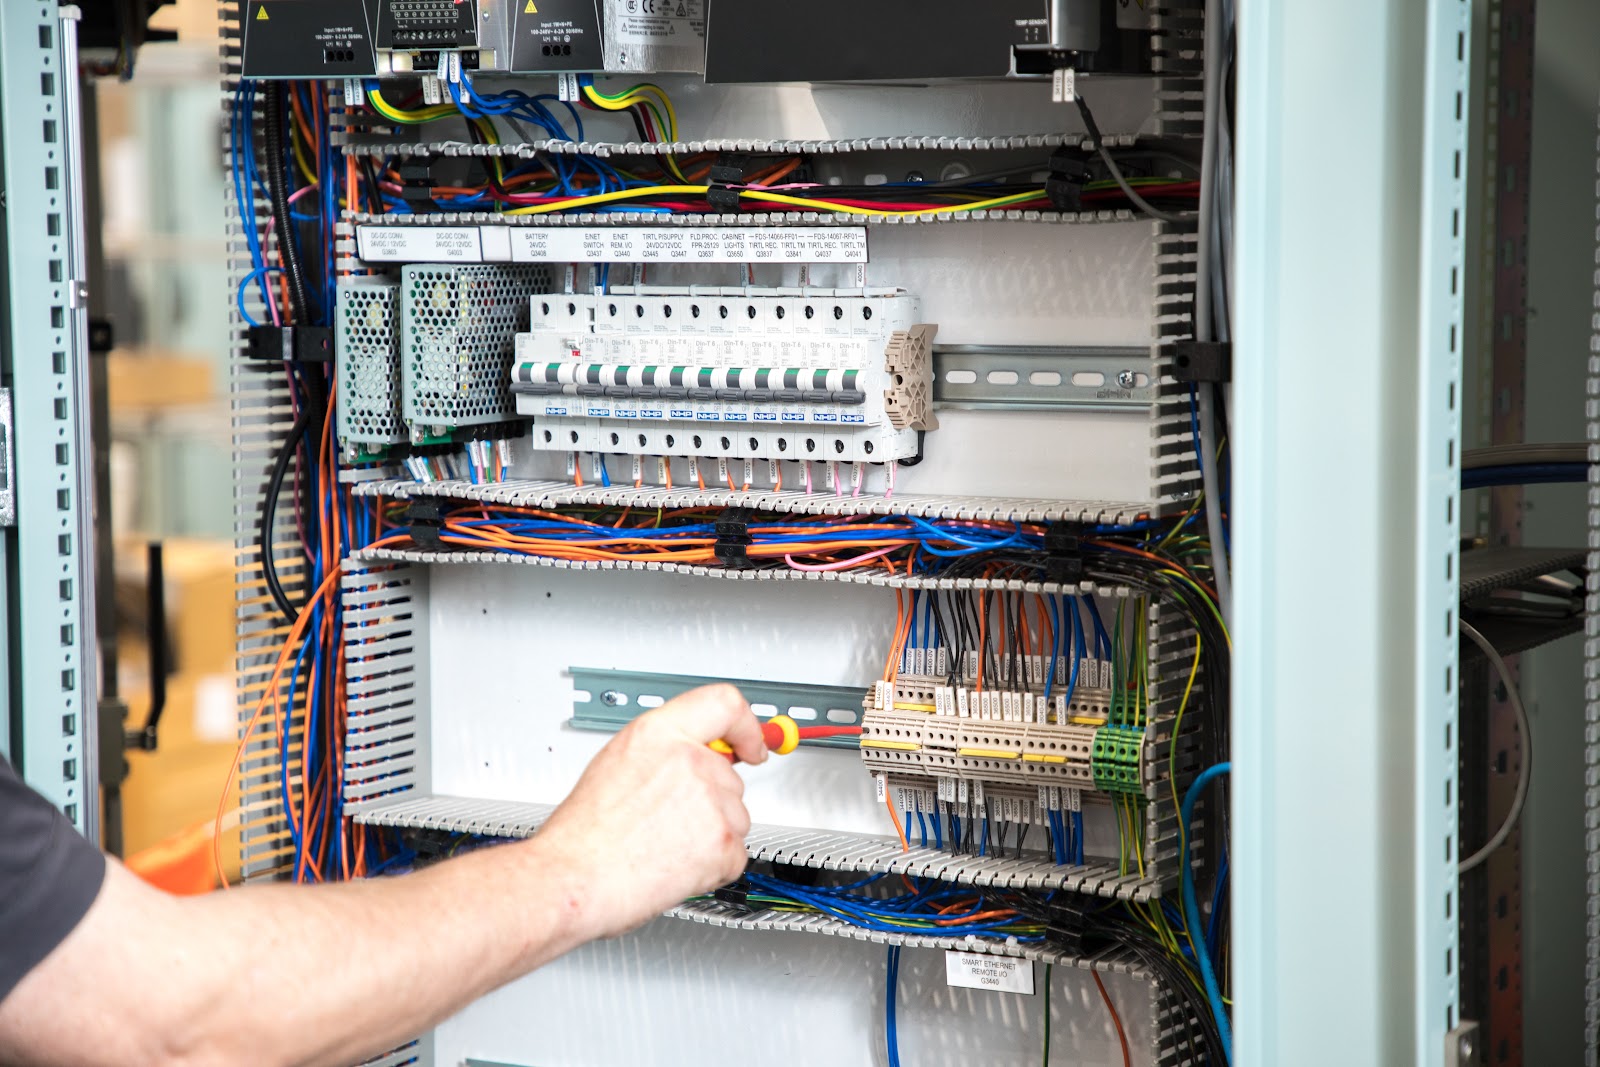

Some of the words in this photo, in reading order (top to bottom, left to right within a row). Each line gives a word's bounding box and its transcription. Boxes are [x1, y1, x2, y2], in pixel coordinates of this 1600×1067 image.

[546, 407, 567, 415] NHP
[640, 410, 662, 418] NHP
[671, 410, 692, 418] NHP
[962, 958, 982, 966] SMART
[984, 961, 1016, 970] ETHERNET
[971, 968, 998, 976] REMOTE
